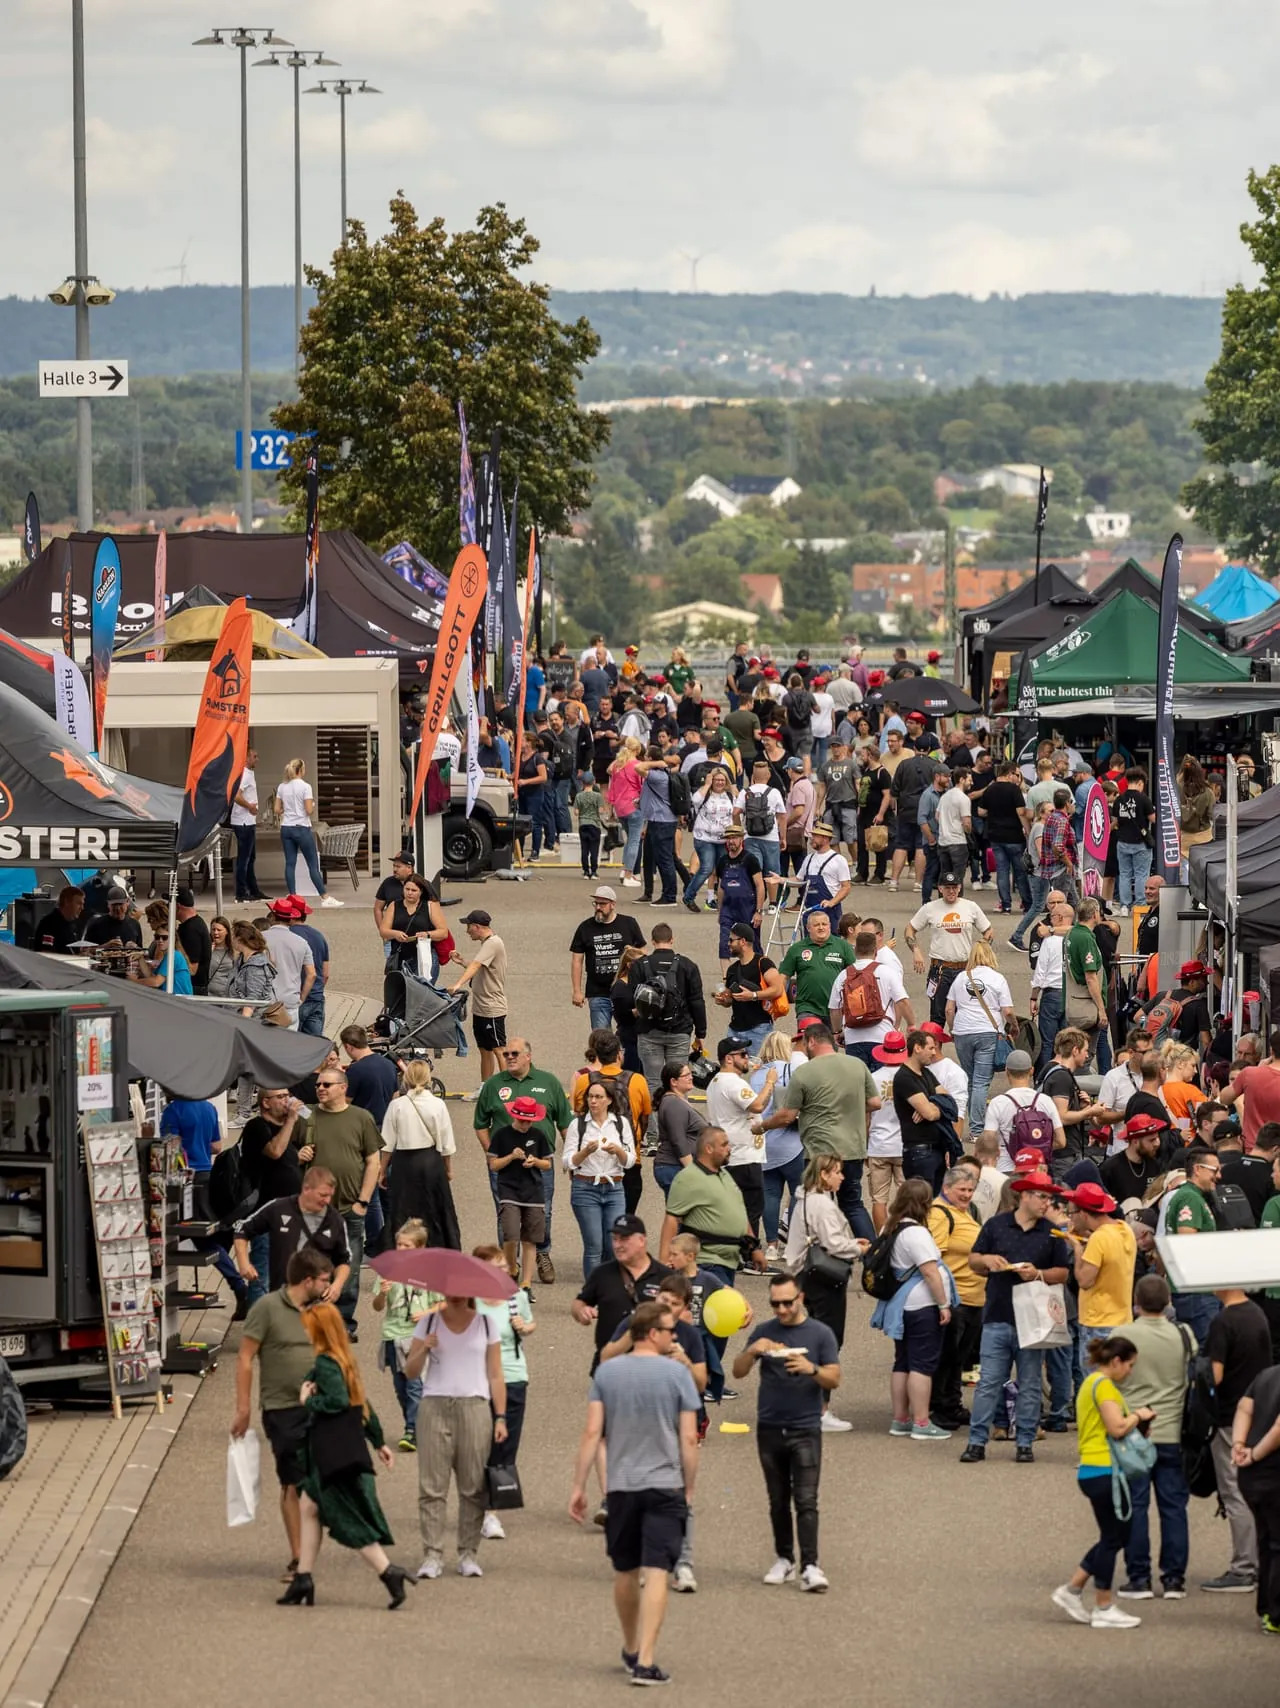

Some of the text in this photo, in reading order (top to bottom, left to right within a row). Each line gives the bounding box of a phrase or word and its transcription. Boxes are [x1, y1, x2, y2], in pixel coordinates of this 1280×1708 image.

[43, 371, 97, 386] Halle 3
[428, 603, 466, 733] GRILLGOTT
[1036, 687, 1055, 696] The
[1058, 686, 1092, 697] hottest
[0, 826, 120, 861] STER!
